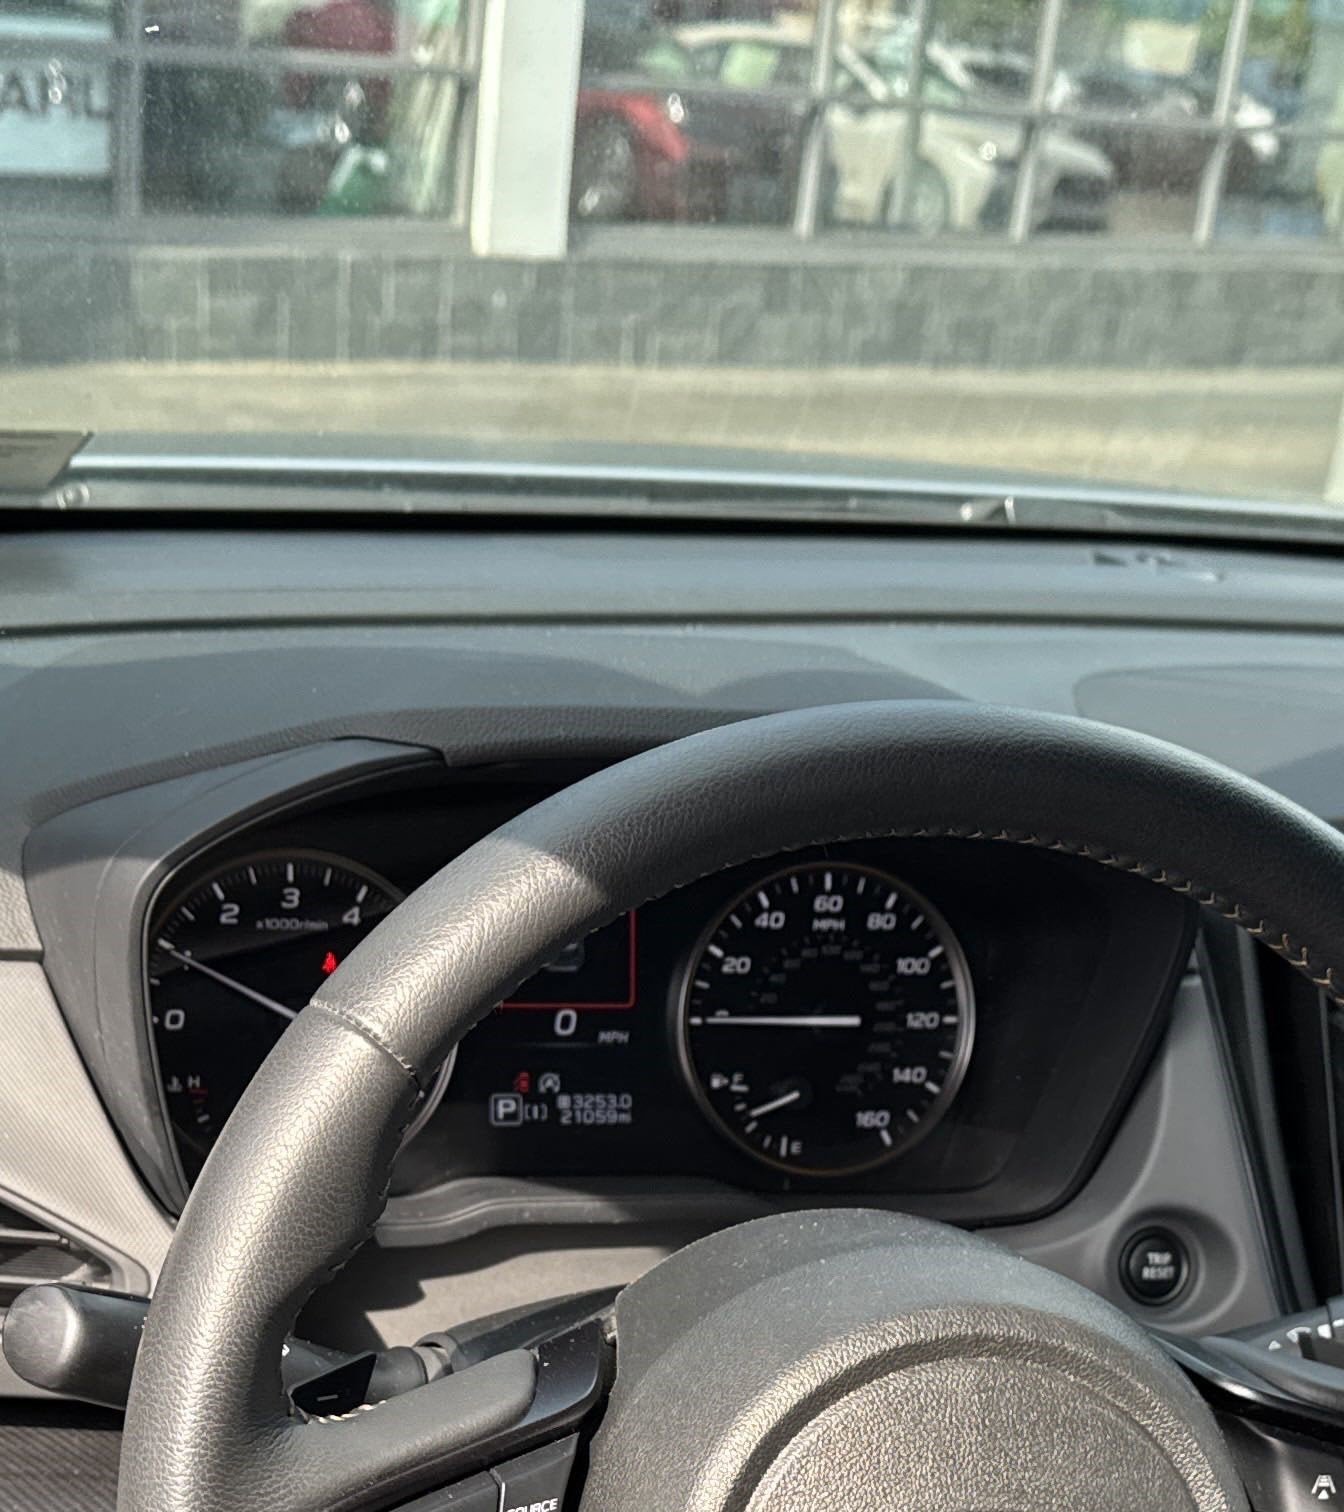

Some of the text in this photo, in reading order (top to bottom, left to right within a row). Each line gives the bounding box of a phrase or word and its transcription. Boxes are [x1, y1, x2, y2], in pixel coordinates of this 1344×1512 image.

[280, 886, 301, 909] 3
[812, 894, 844, 913] 60
[218, 903, 240, 925] 2
[341, 905, 362, 926] 4
[754, 910, 786, 930] 40
[865, 912, 897, 931] 80
[811, 917, 846, 932] MPH
[721, 955, 753, 975] 20
[895, 956, 932, 975] 100
[163, 1008, 186, 1031] 0
[554, 1008, 578, 1037] 0
[905, 1011, 941, 1030] 120
[597, 1031, 630, 1045] MPH
[891, 1065, 929, 1084] 140
[854, 1110, 892, 1129] 160
[789, 1141, 803, 1154] E
